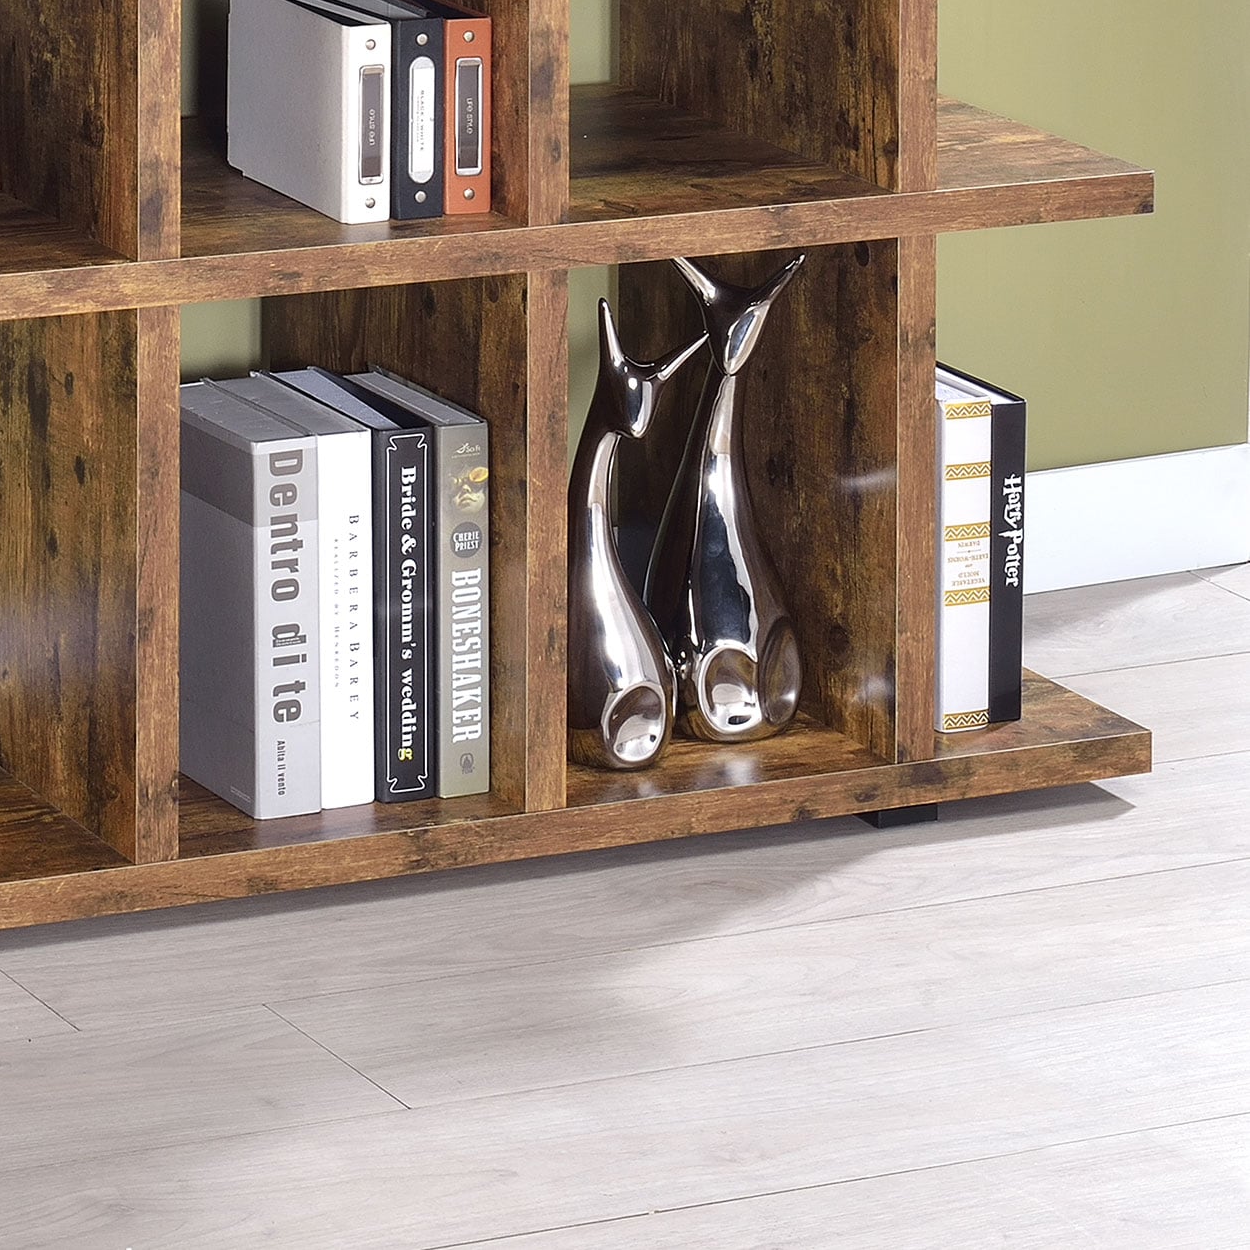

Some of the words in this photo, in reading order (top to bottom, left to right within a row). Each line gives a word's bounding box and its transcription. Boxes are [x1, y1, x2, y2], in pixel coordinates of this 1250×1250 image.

[269, 448, 304, 604] Dentro
[400, 466, 417, 531] Bride
[1002, 473, 1022, 528] Harry
[400, 534, 417, 555] &
[453, 531, 480, 543] CHERIE
[455, 540, 479, 552] PRIEST
[998, 528, 1023, 587] Potter
[348, 514, 360, 630] BARBERA
[400, 559, 417, 660] Gromm's
[349, 643, 360, 721] BAREY
[451, 567, 482, 743] BONESHAKER
[398, 669, 417, 762] wedding
[278, 772, 286, 796] vento
